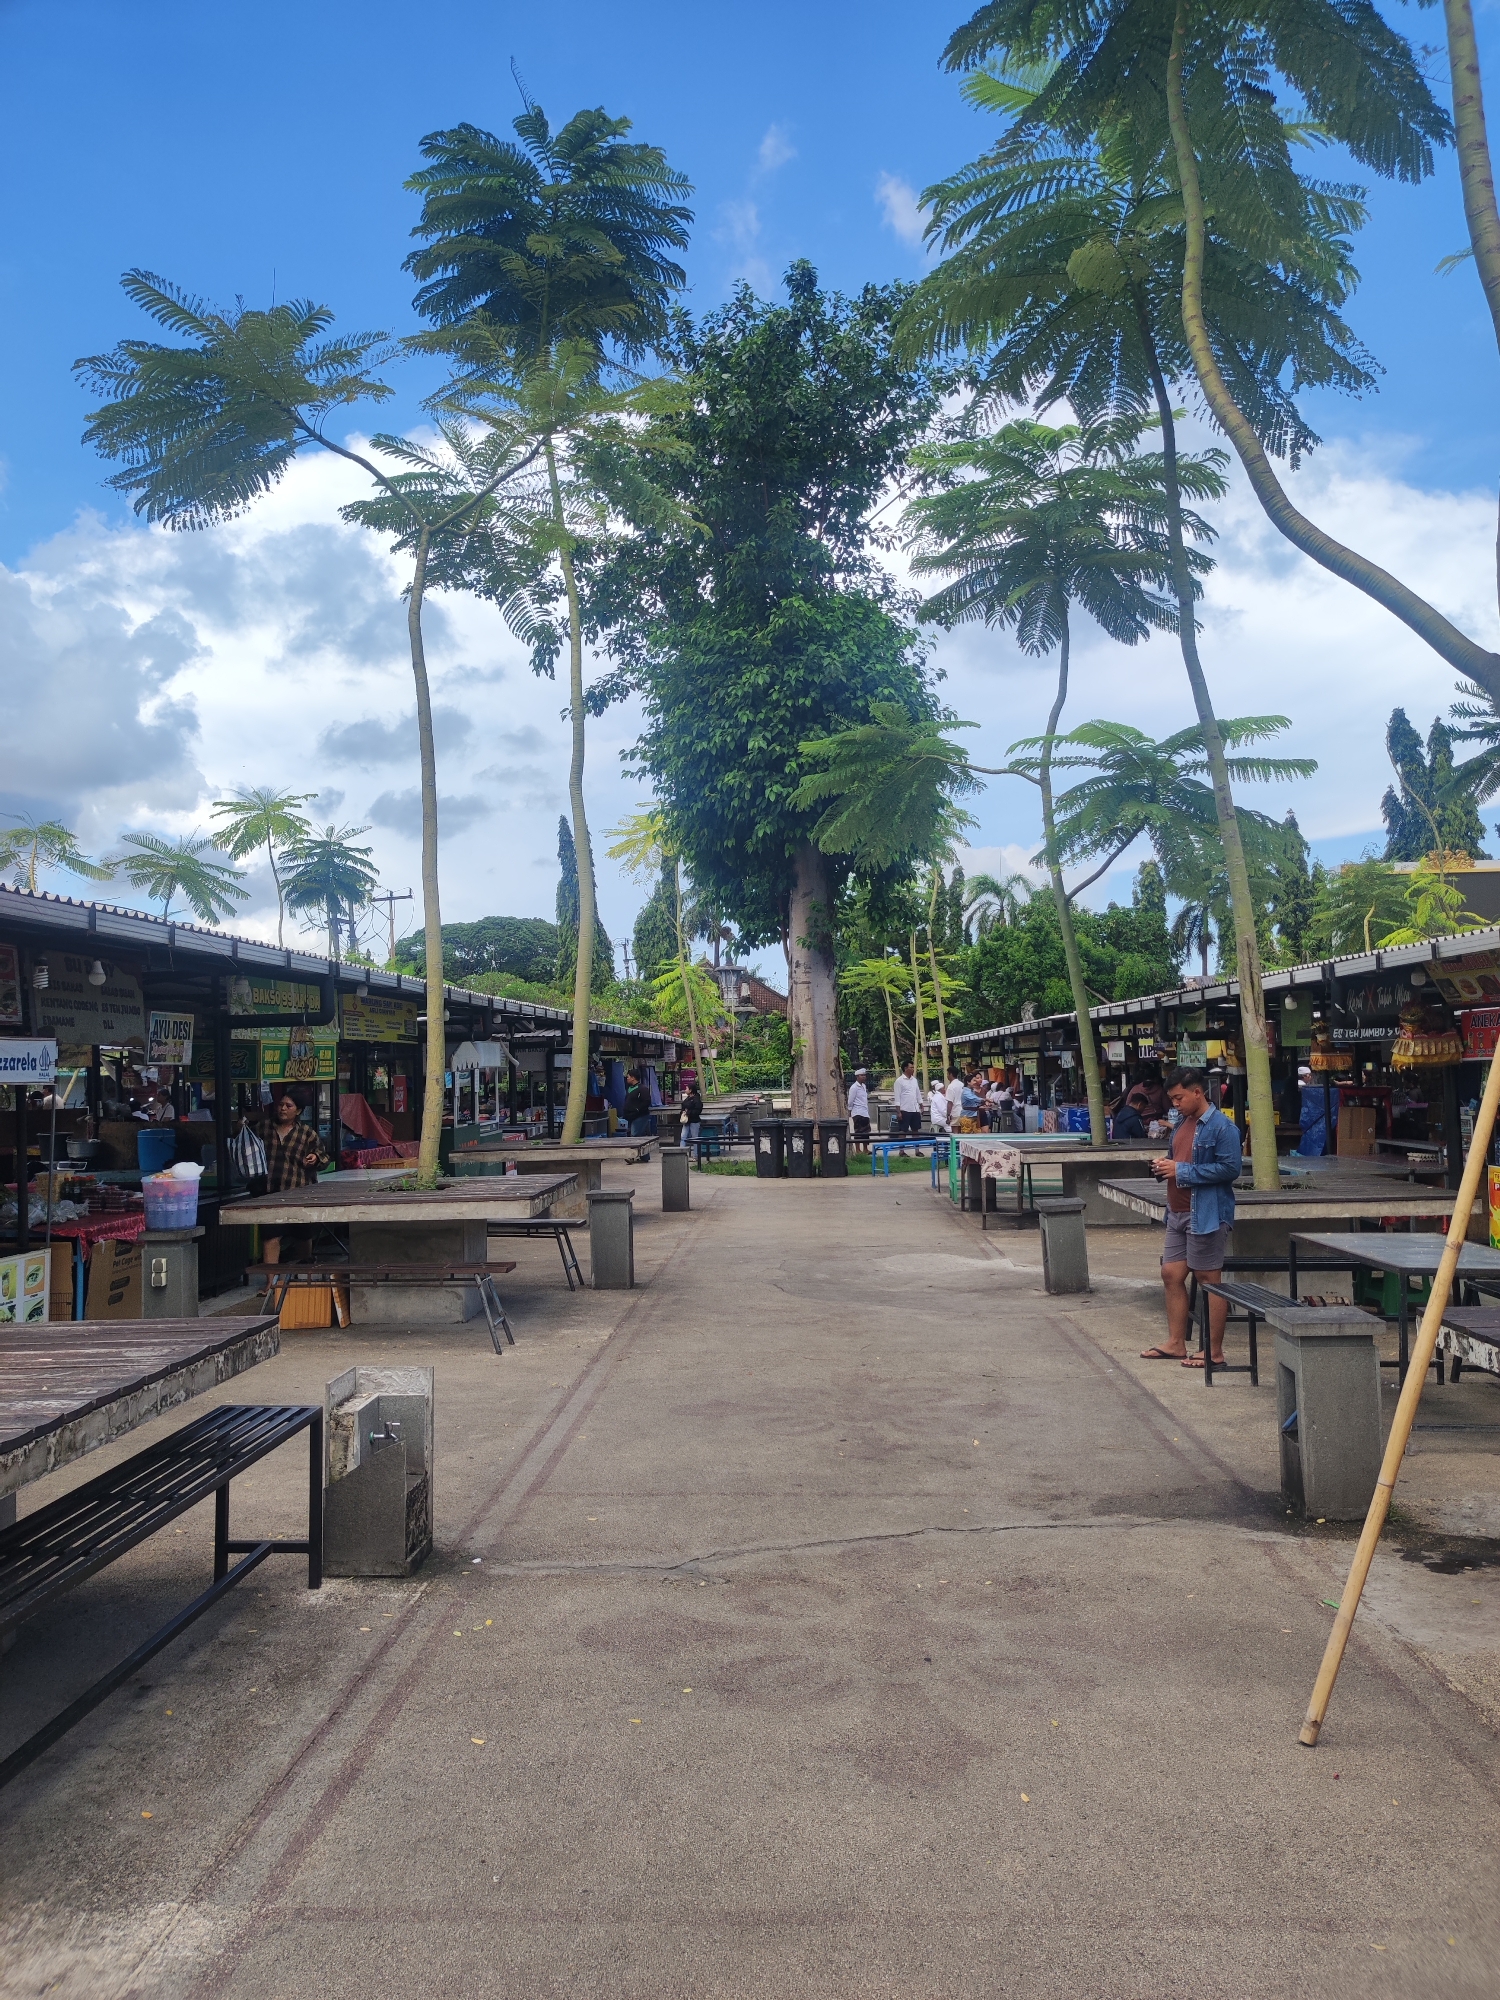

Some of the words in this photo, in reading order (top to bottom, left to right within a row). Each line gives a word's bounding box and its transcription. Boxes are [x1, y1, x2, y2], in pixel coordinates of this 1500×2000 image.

[40, 996, 73, 1010] KENTANG
[252, 987, 280, 1006] BAKSO
[281, 991, 292, 1008] 99
[152, 1019, 170, 1040] AYU
[172, 1020, 191, 1040] DESI
[1333, 1028, 1343, 1038] ES
[1344, 1028, 1359, 1038] TEH
[1360, 1027, 1385, 1038] JUMBO
